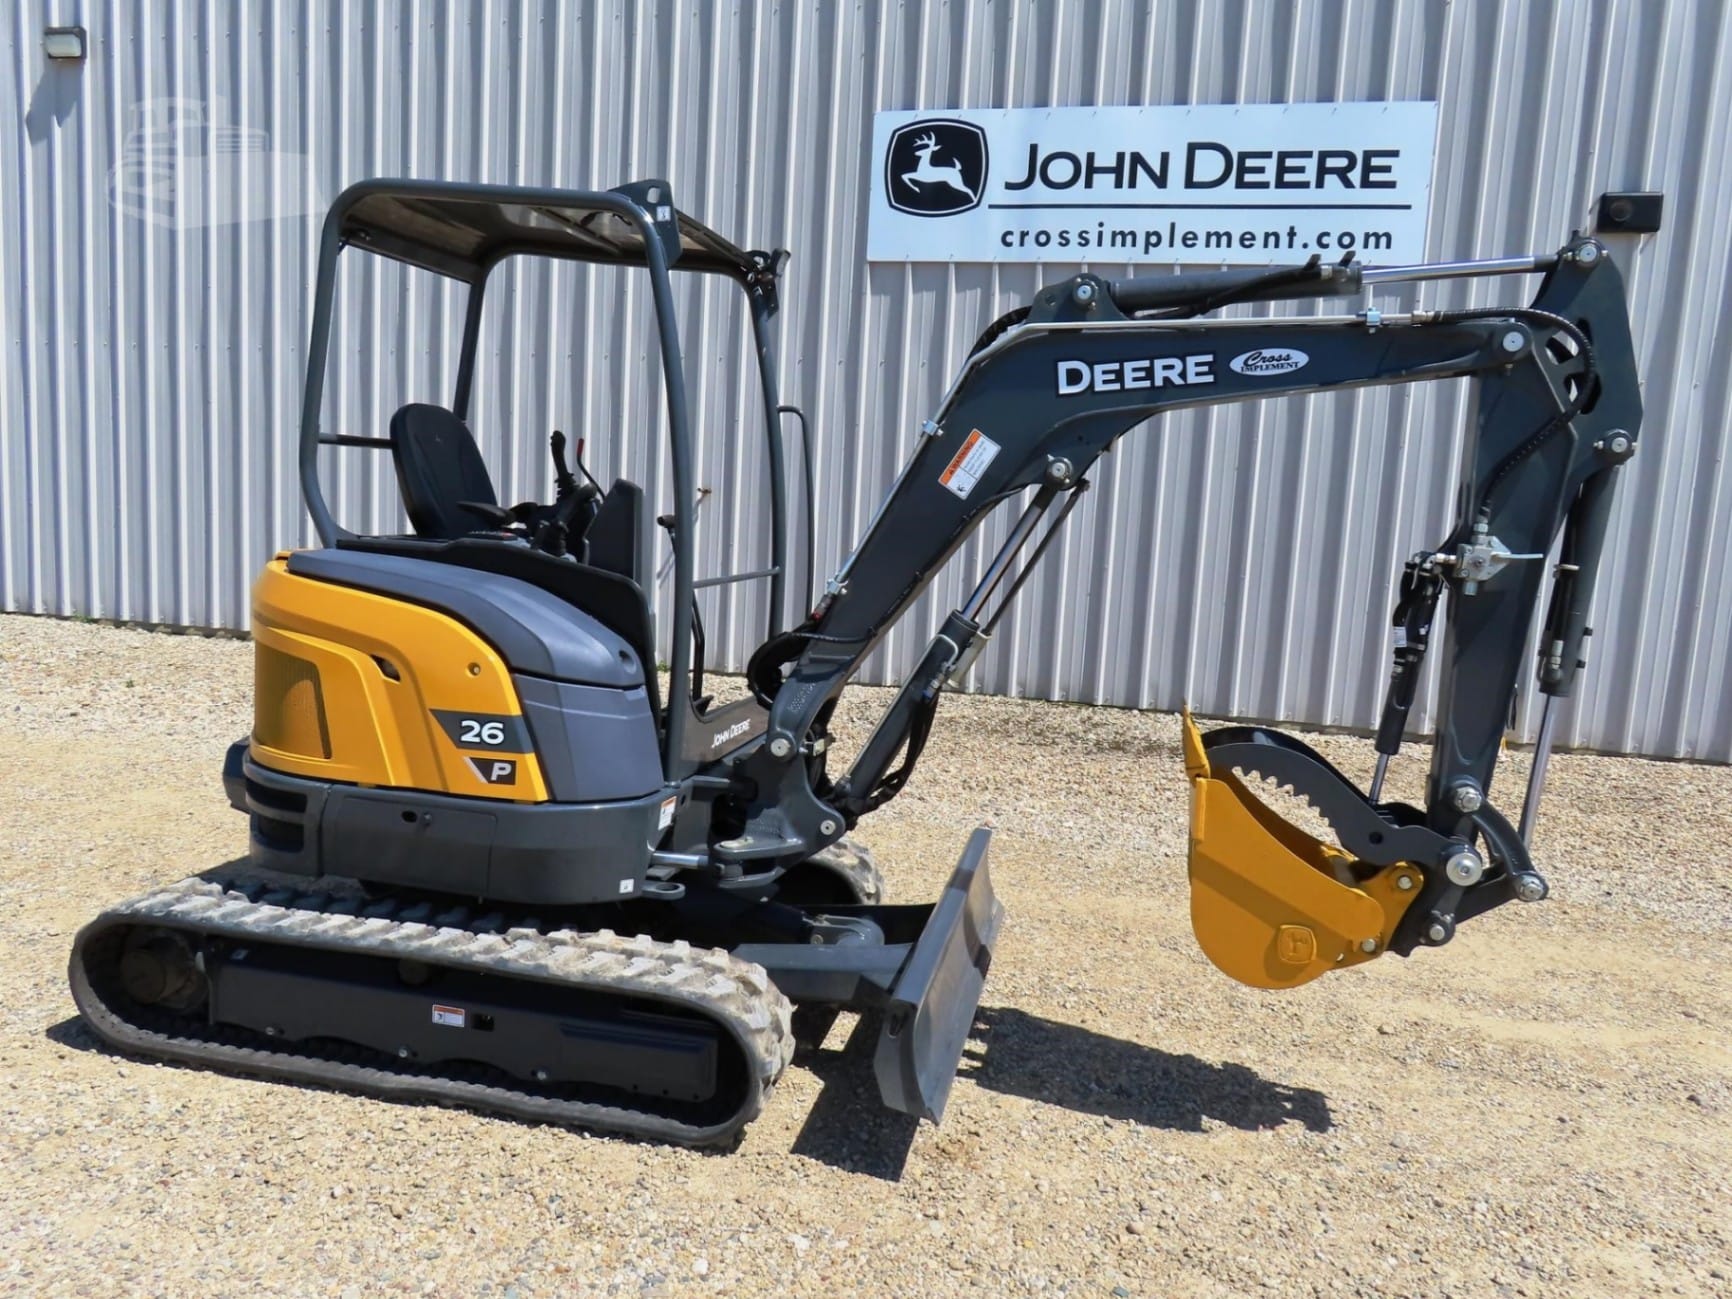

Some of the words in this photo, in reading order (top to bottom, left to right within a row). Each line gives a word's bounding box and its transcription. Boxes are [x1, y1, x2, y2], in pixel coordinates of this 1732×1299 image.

[1004, 143, 1170, 191] JOHN
[1184, 142, 1400, 190] DEERE
[1000, 222, 1393, 255] crossimplement.com
[1240, 361, 1299, 373] IMPLEMENT
[1244, 350, 1292, 366] Cross
[1057, 354, 1215, 395] DEERE
[460, 720, 505, 745] 26
[711, 729, 730, 748] JOHN
[730, 718, 751, 738] DEERE
[490, 762, 512, 781] P
